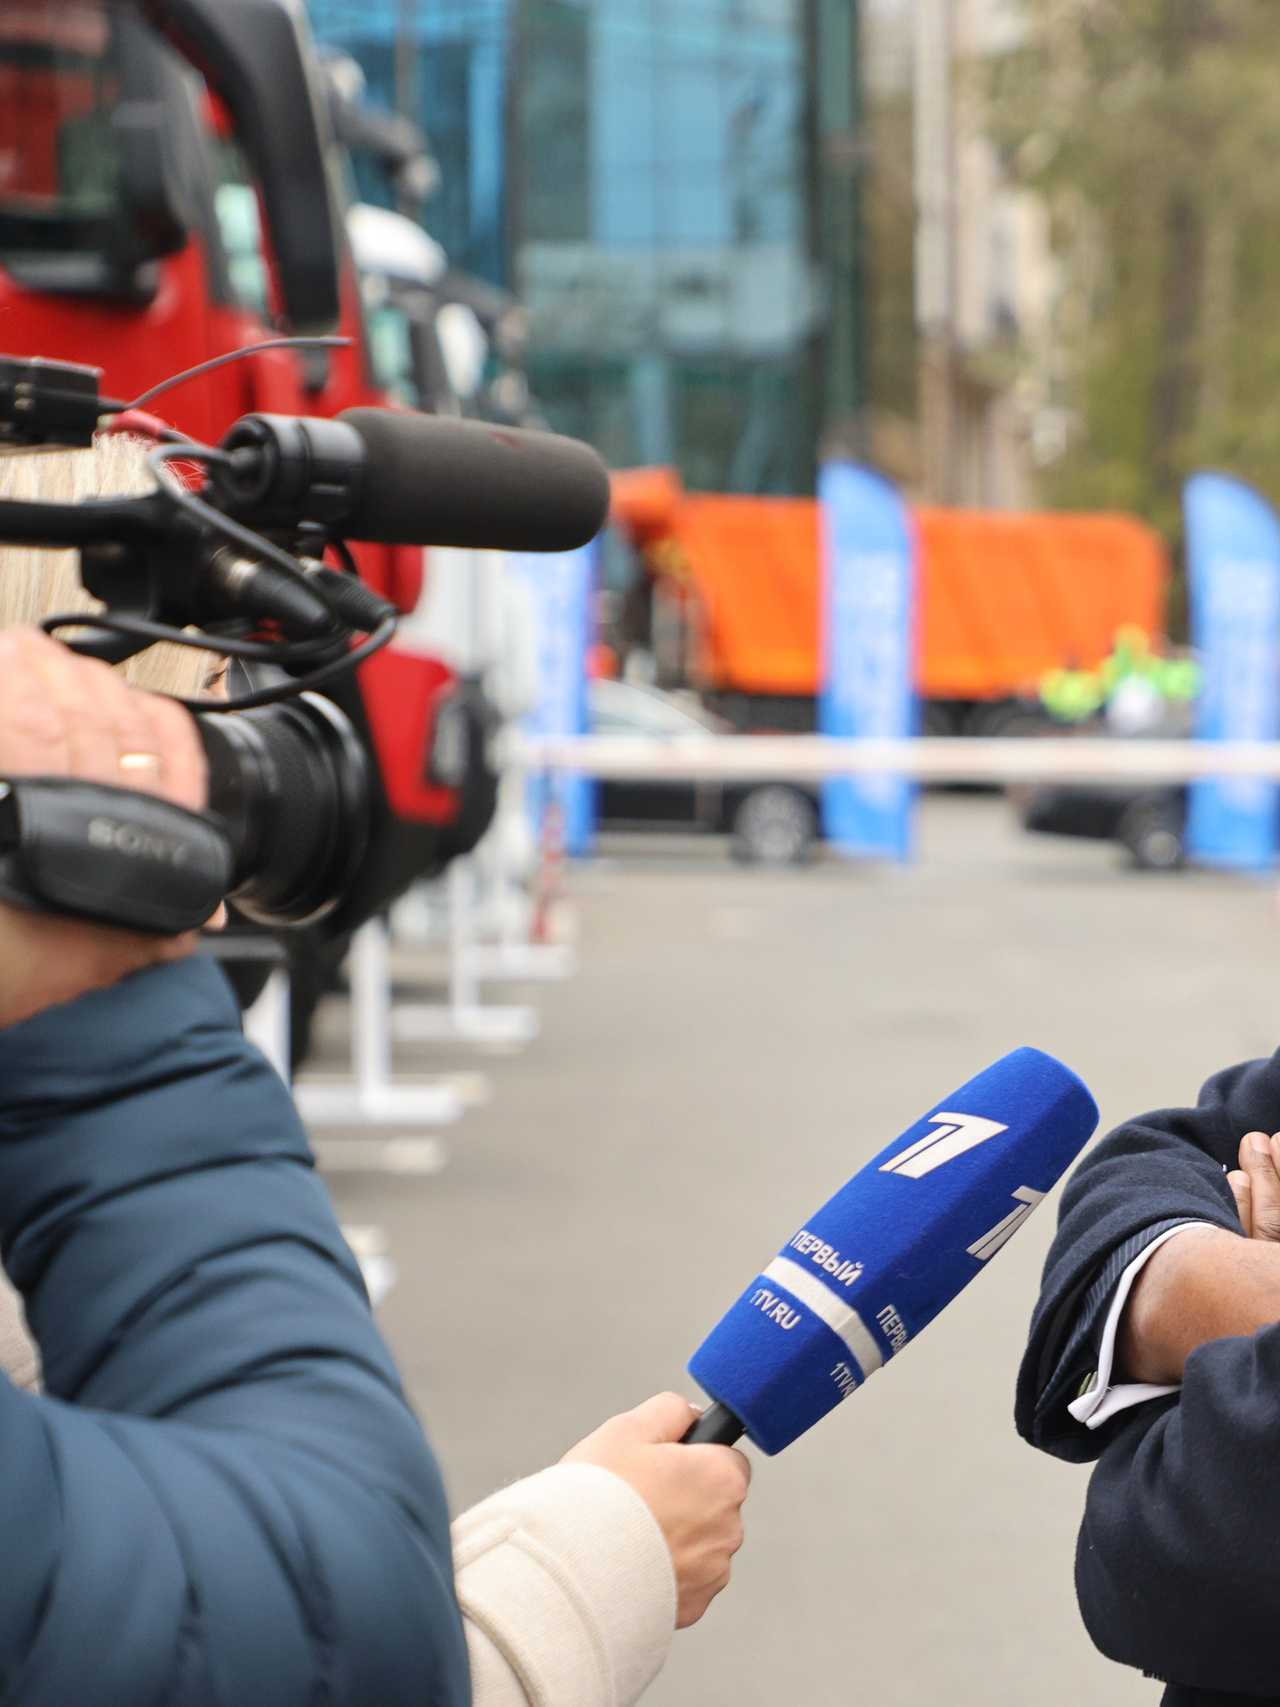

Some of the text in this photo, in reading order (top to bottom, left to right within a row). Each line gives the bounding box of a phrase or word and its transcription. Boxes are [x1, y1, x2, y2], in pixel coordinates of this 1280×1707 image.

[87, 817, 192, 867] SONY
[789, 1229, 865, 1287] ПЕРВЫЙ
[749, 1288, 802, 1331] 1TV.RU
